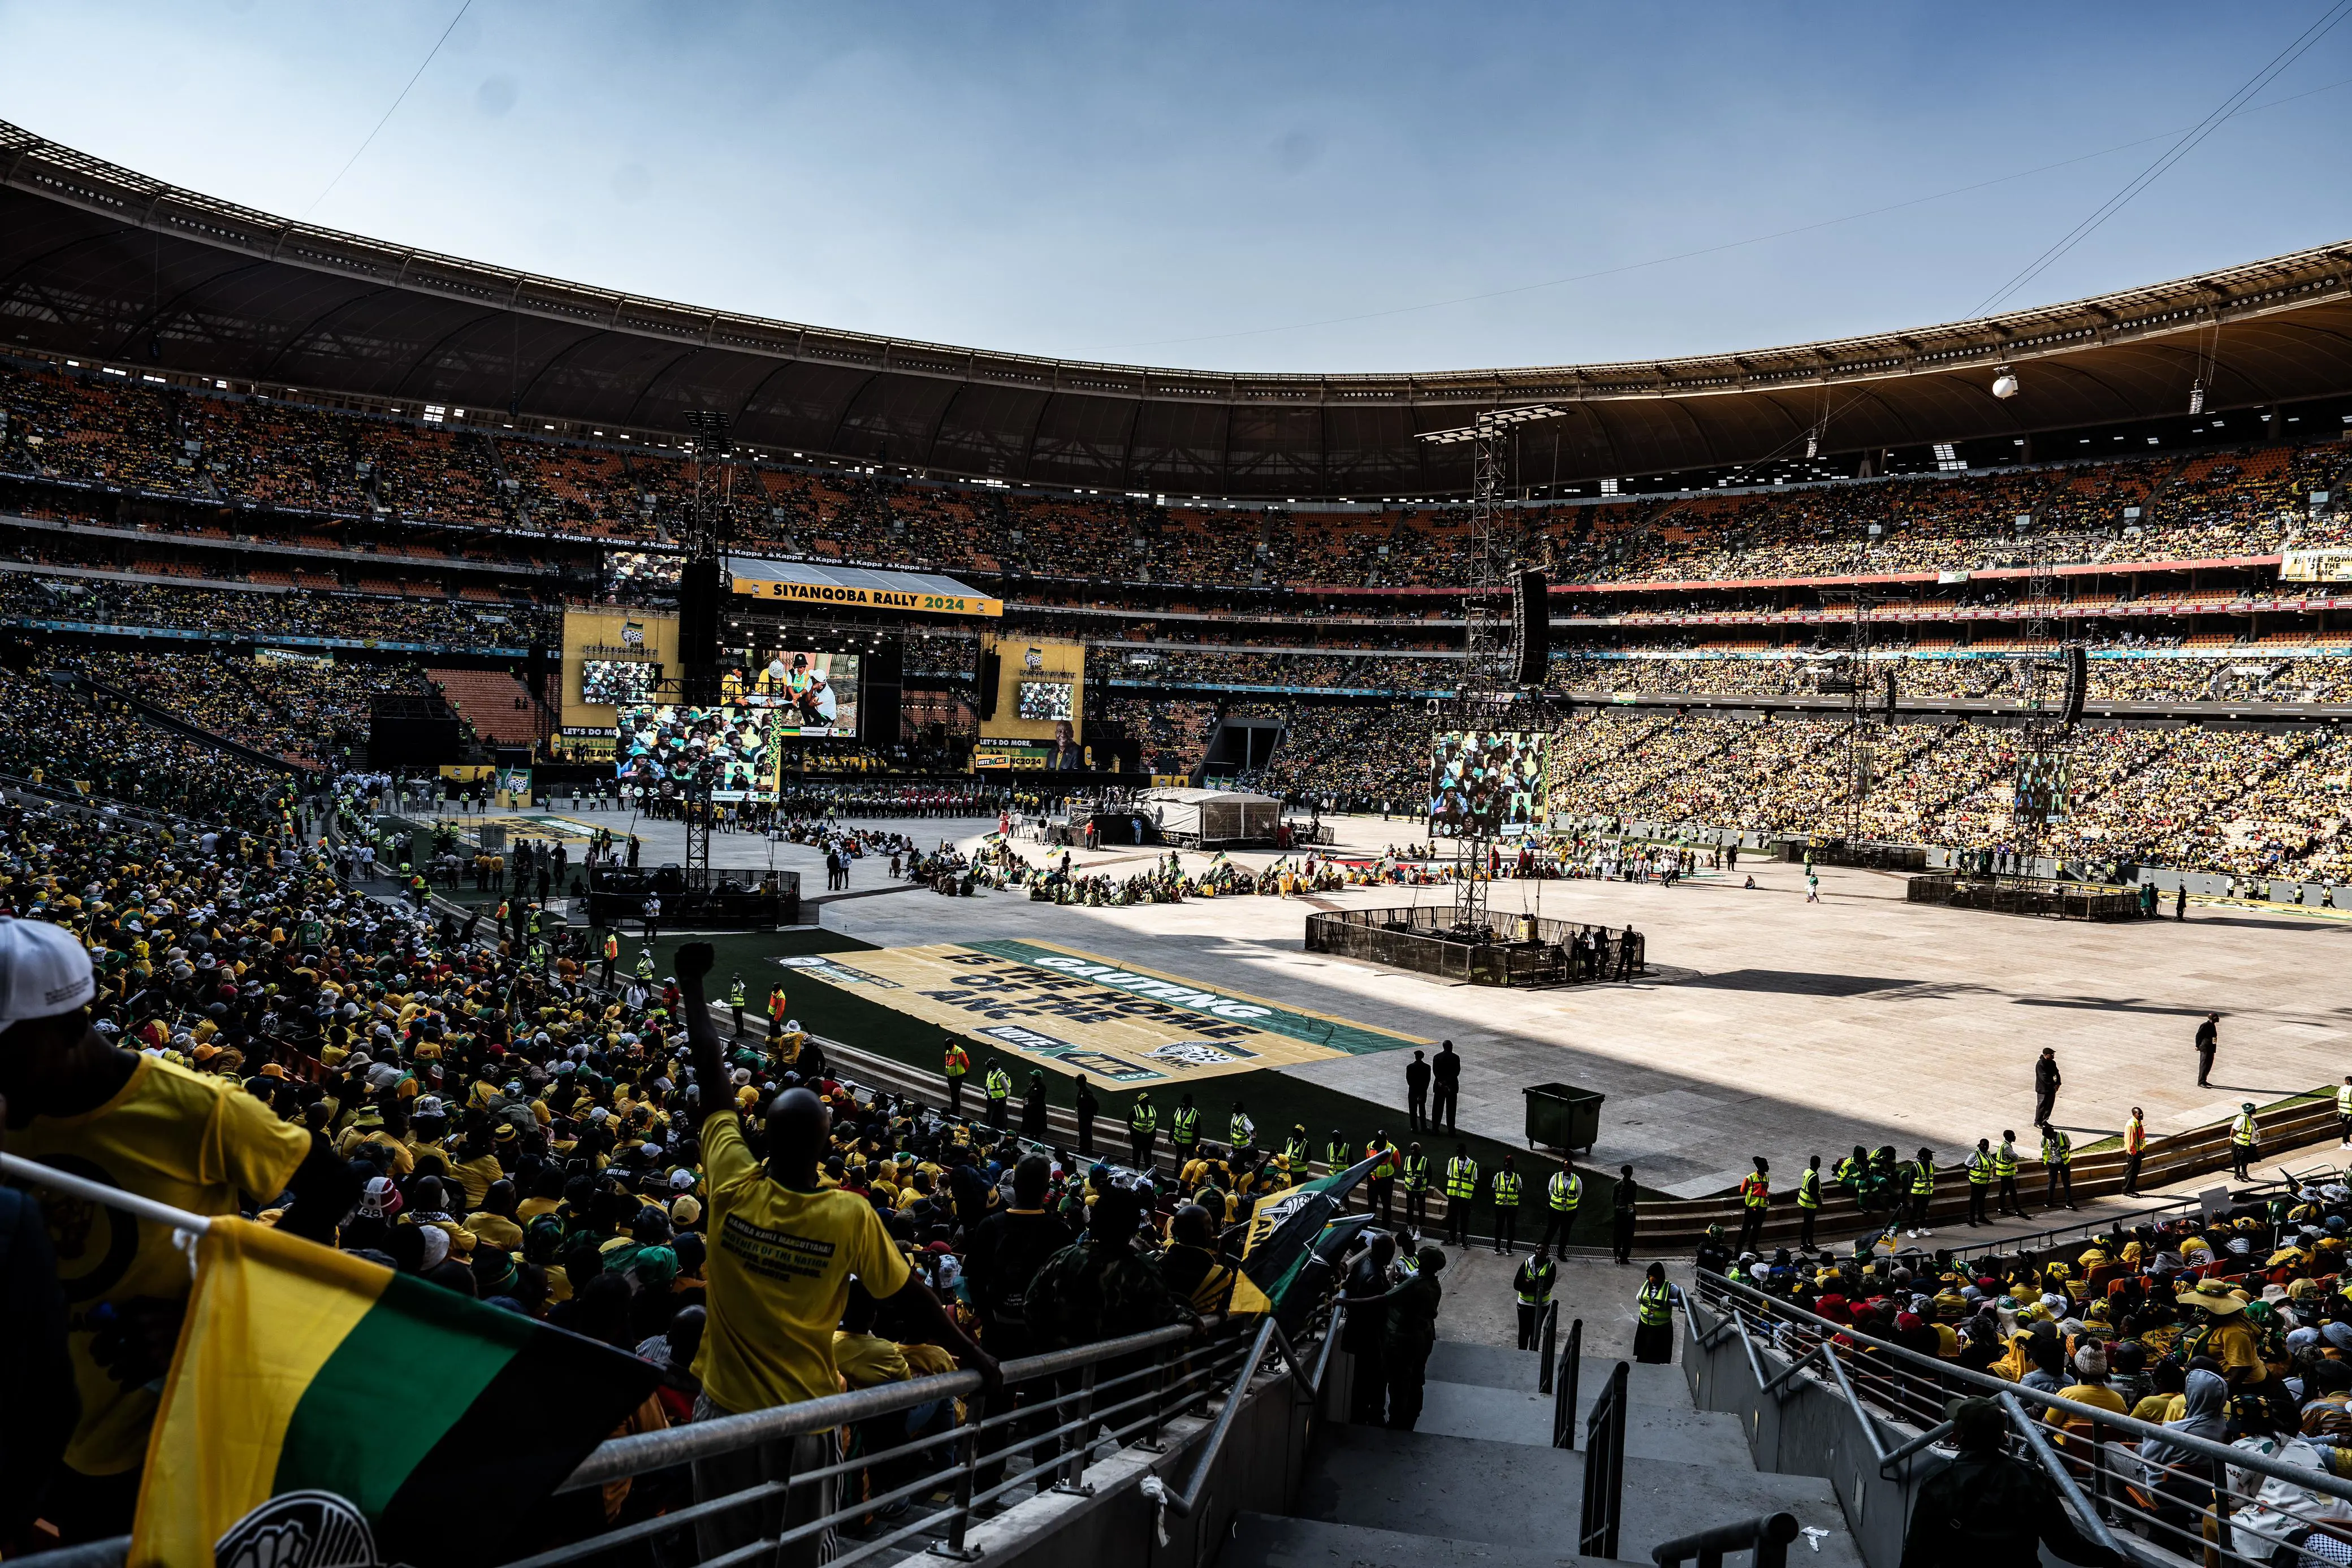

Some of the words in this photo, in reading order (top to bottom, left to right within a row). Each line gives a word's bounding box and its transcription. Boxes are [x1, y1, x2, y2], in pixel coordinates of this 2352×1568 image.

[515, 530, 546, 538] Kappa
[562, 534, 592, 542] Kappa
[735, 548, 762, 557] Kappa
[773, 584, 867, 603] SIYANQOBA
[874, 592, 918, 607] RALLY
[924, 597, 965, 610] 2024
[647, 787, 660, 796] 30
[1454, 825, 1463, 834] 30
[799, 968, 823, 976] VOTE
[939, 954, 1006, 965] IS
[989, 966, 1093, 990] THE
[1075, 991, 1263, 1038] HOME
[1034, 957, 1272, 1017] GAUTENG
[916, 990, 1043, 1020] ANC
[950, 974, 1032, 992] OF
[1015, 994, 1131, 1024] THE
[987, 1026, 1059, 1048] VOTE
[1061, 1053, 1136, 1075] ANC
[1116, 1071, 1158, 1081] 2024
[1154, 1055, 1200, 1068] ANC
[362, 1207, 381, 1218] 98
[728, 1217, 755, 1236] HAMBA
[755, 1229, 779, 1241] KAHLE
[721, 1229, 759, 1251] MOTHER
[761, 1246, 774, 1256] OF
[775, 1250, 792, 1262] THE
[794, 1255, 829, 1268] NATION
